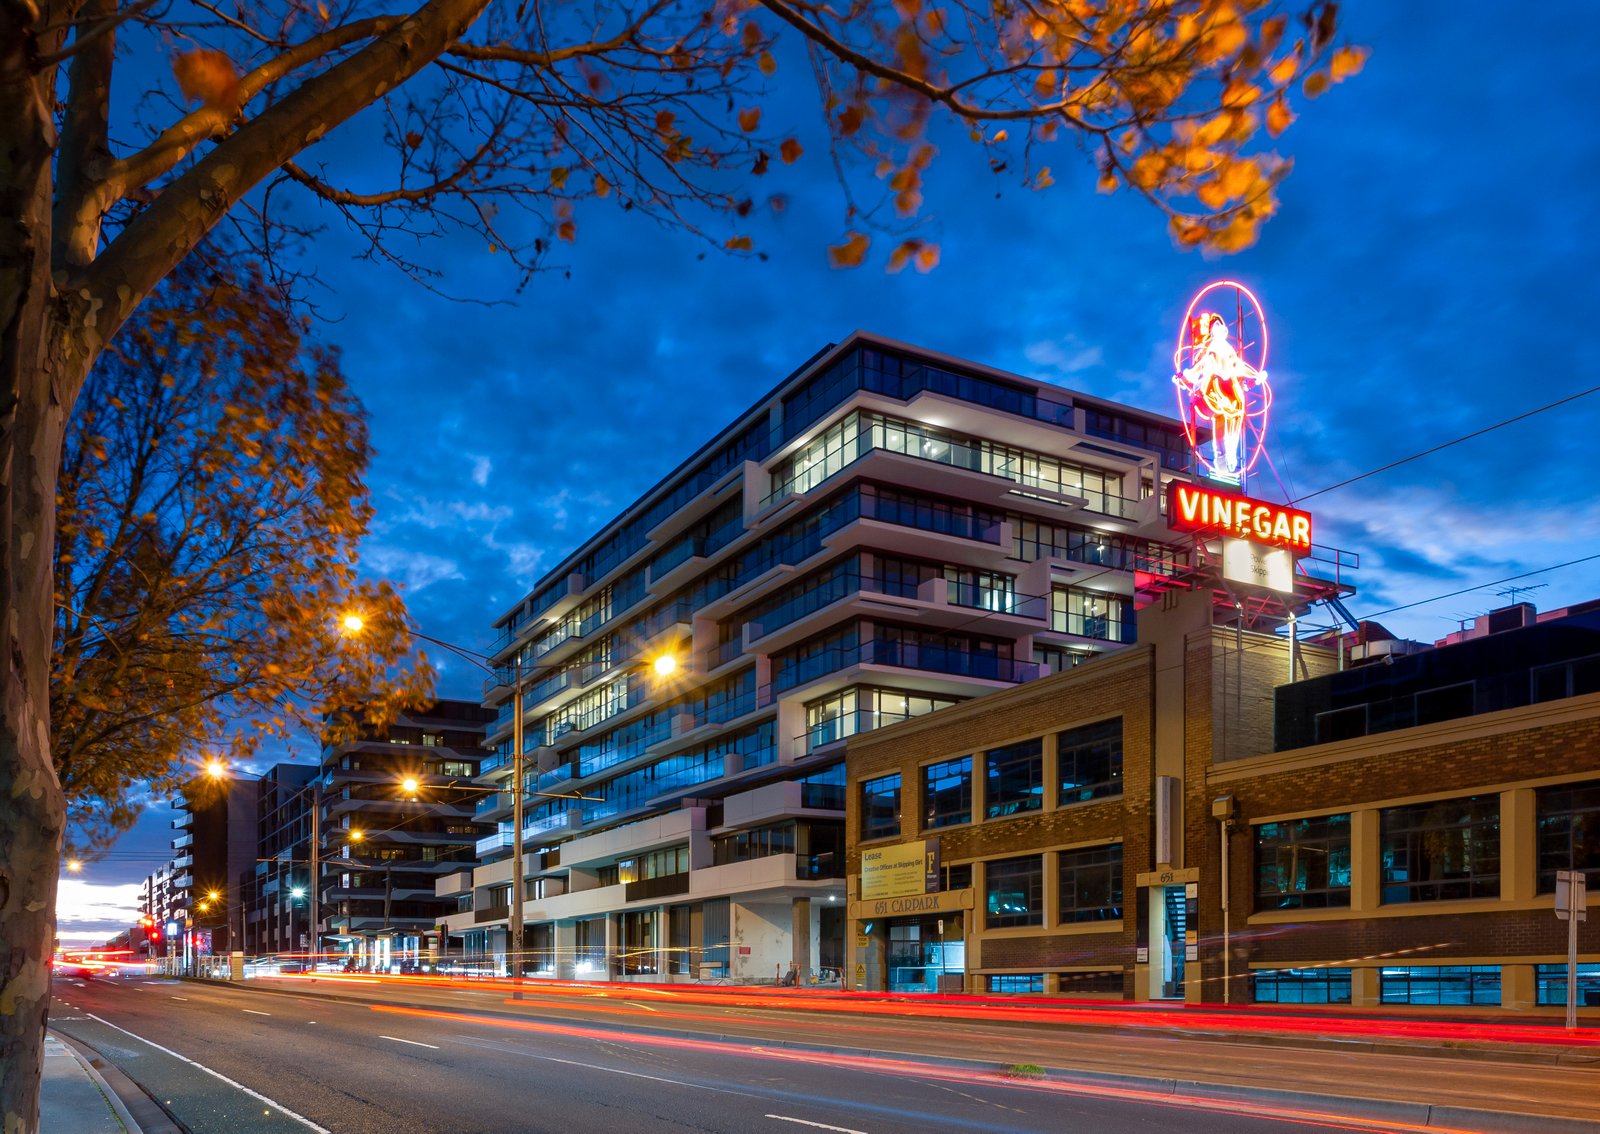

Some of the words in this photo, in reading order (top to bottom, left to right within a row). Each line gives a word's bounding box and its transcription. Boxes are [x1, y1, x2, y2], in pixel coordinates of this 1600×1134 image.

[1178, 487, 1310, 547] VINEGAR
[864, 852, 882, 861] Lease
[879, 863, 893, 871] Offices
[897, 860, 915, 869] Skipping
[1160, 872, 1174, 883] 651
[874, 902, 888, 915] 651
[891, 896, 940, 913] CARPARK
